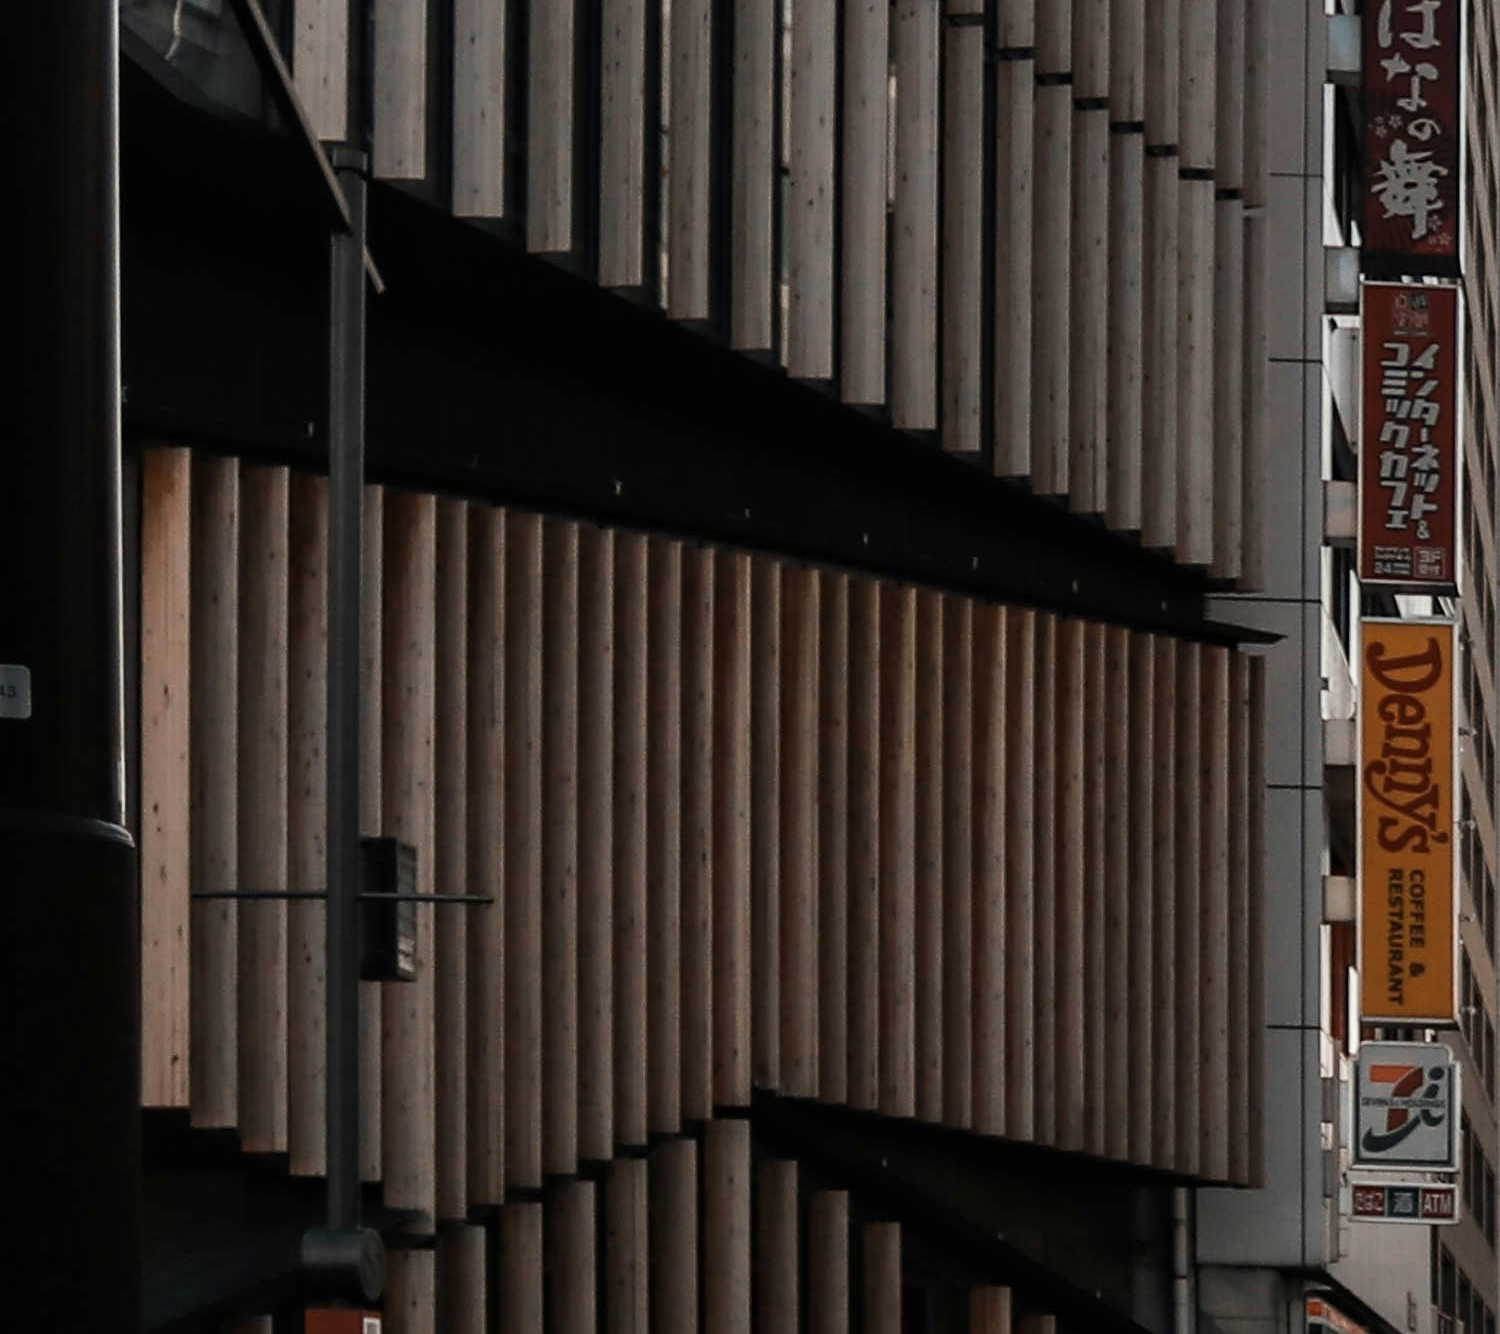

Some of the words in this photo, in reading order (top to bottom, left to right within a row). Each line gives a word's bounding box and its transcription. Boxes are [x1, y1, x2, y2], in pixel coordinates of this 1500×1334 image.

[1380, 343, 1410, 529] コミックカフェ
[1410, 343, 1440, 539] インターネット&
[1366, 637, 1449, 854] Denny's
[1388, 869, 1403, 1005] RESTAURANT
[1409, 962, 1425, 978] &
[1410, 870, 1425, 948] COFFEE
[1424, 1193, 1450, 1214] ATM
